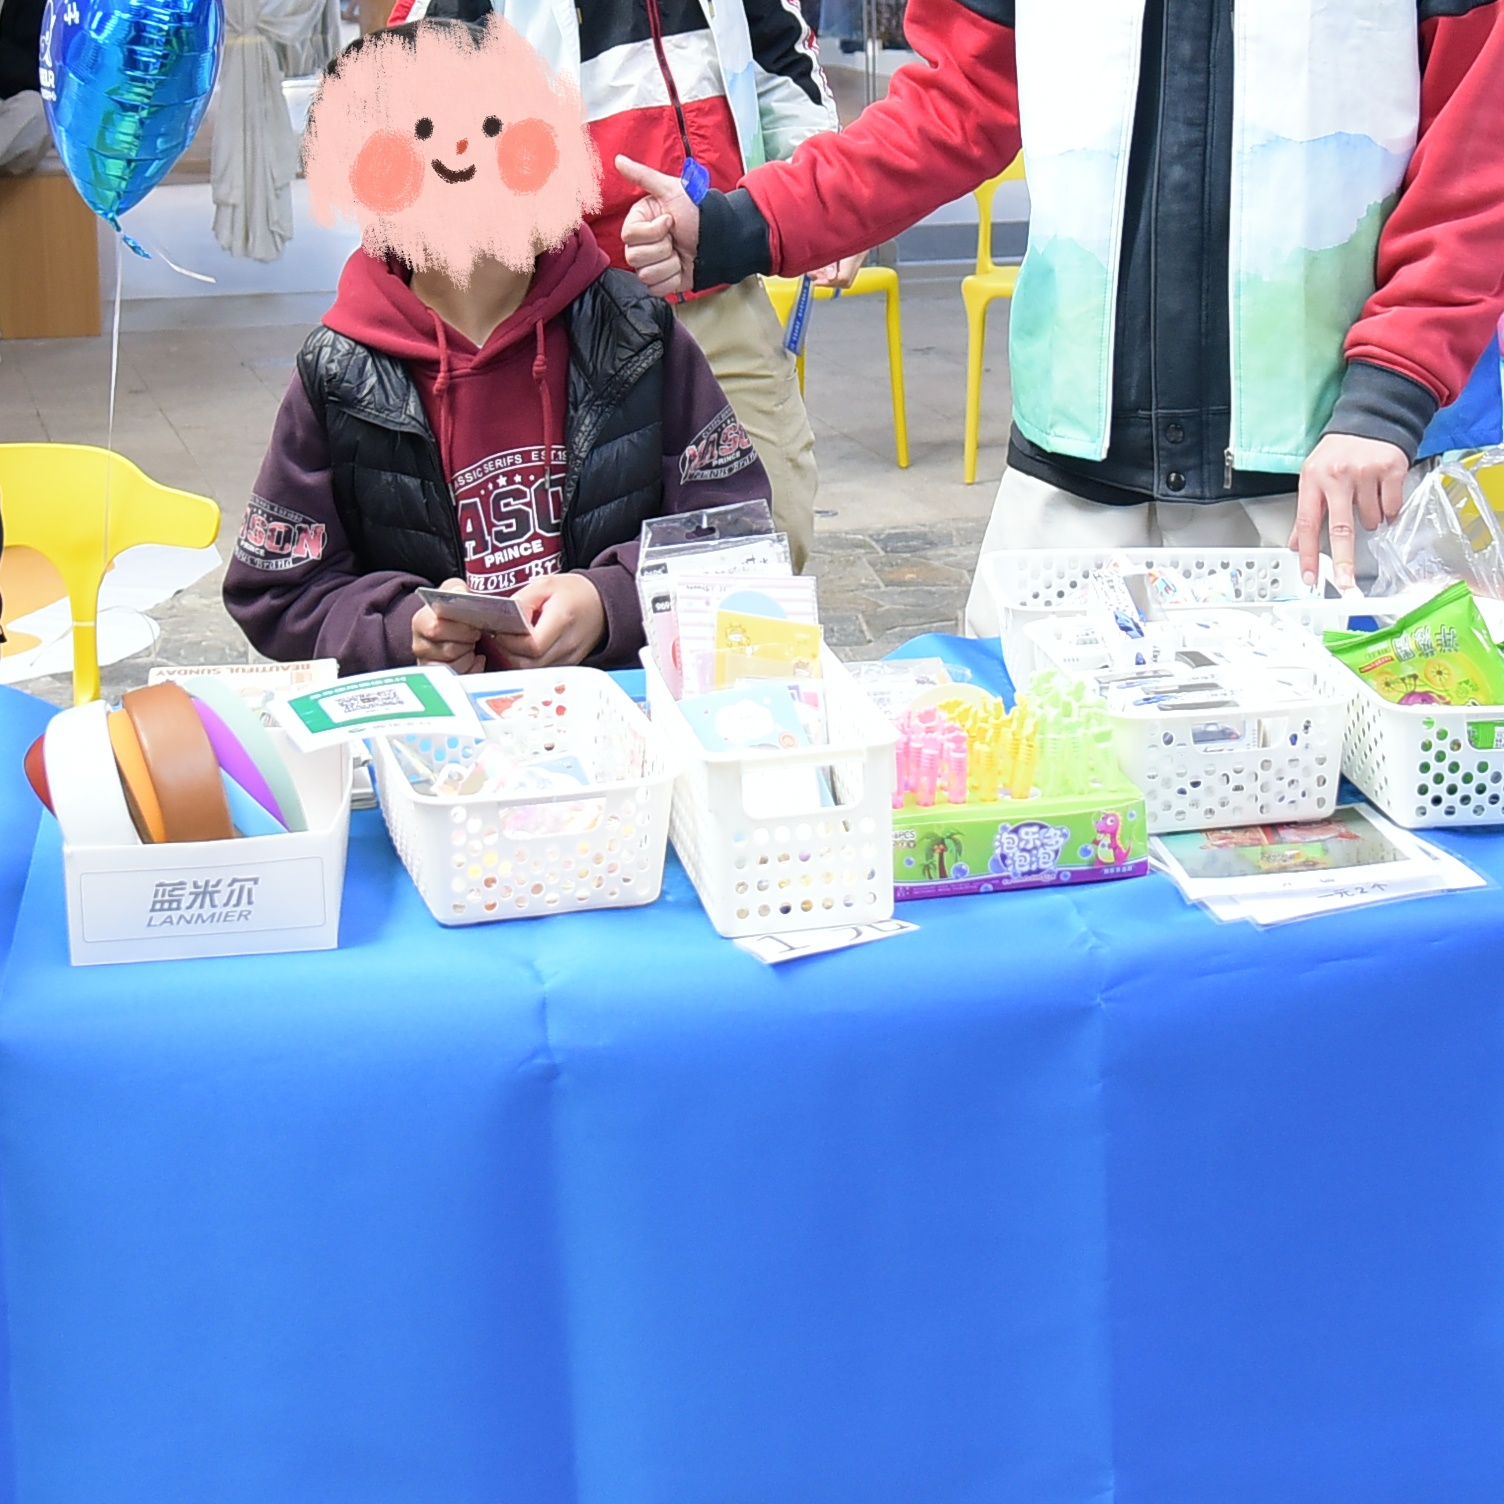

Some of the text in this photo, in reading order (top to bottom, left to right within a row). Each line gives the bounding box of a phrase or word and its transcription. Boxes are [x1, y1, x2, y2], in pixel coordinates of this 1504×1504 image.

[484, 453, 522, 473] SERIFS
[484, 539, 544, 569] PRINCE
[156, 662, 311, 677] BEAUTIFUL SUNDAY
[149, 876, 259, 912] 蓝米尔
[146, 909, 252, 927] LANMIER
